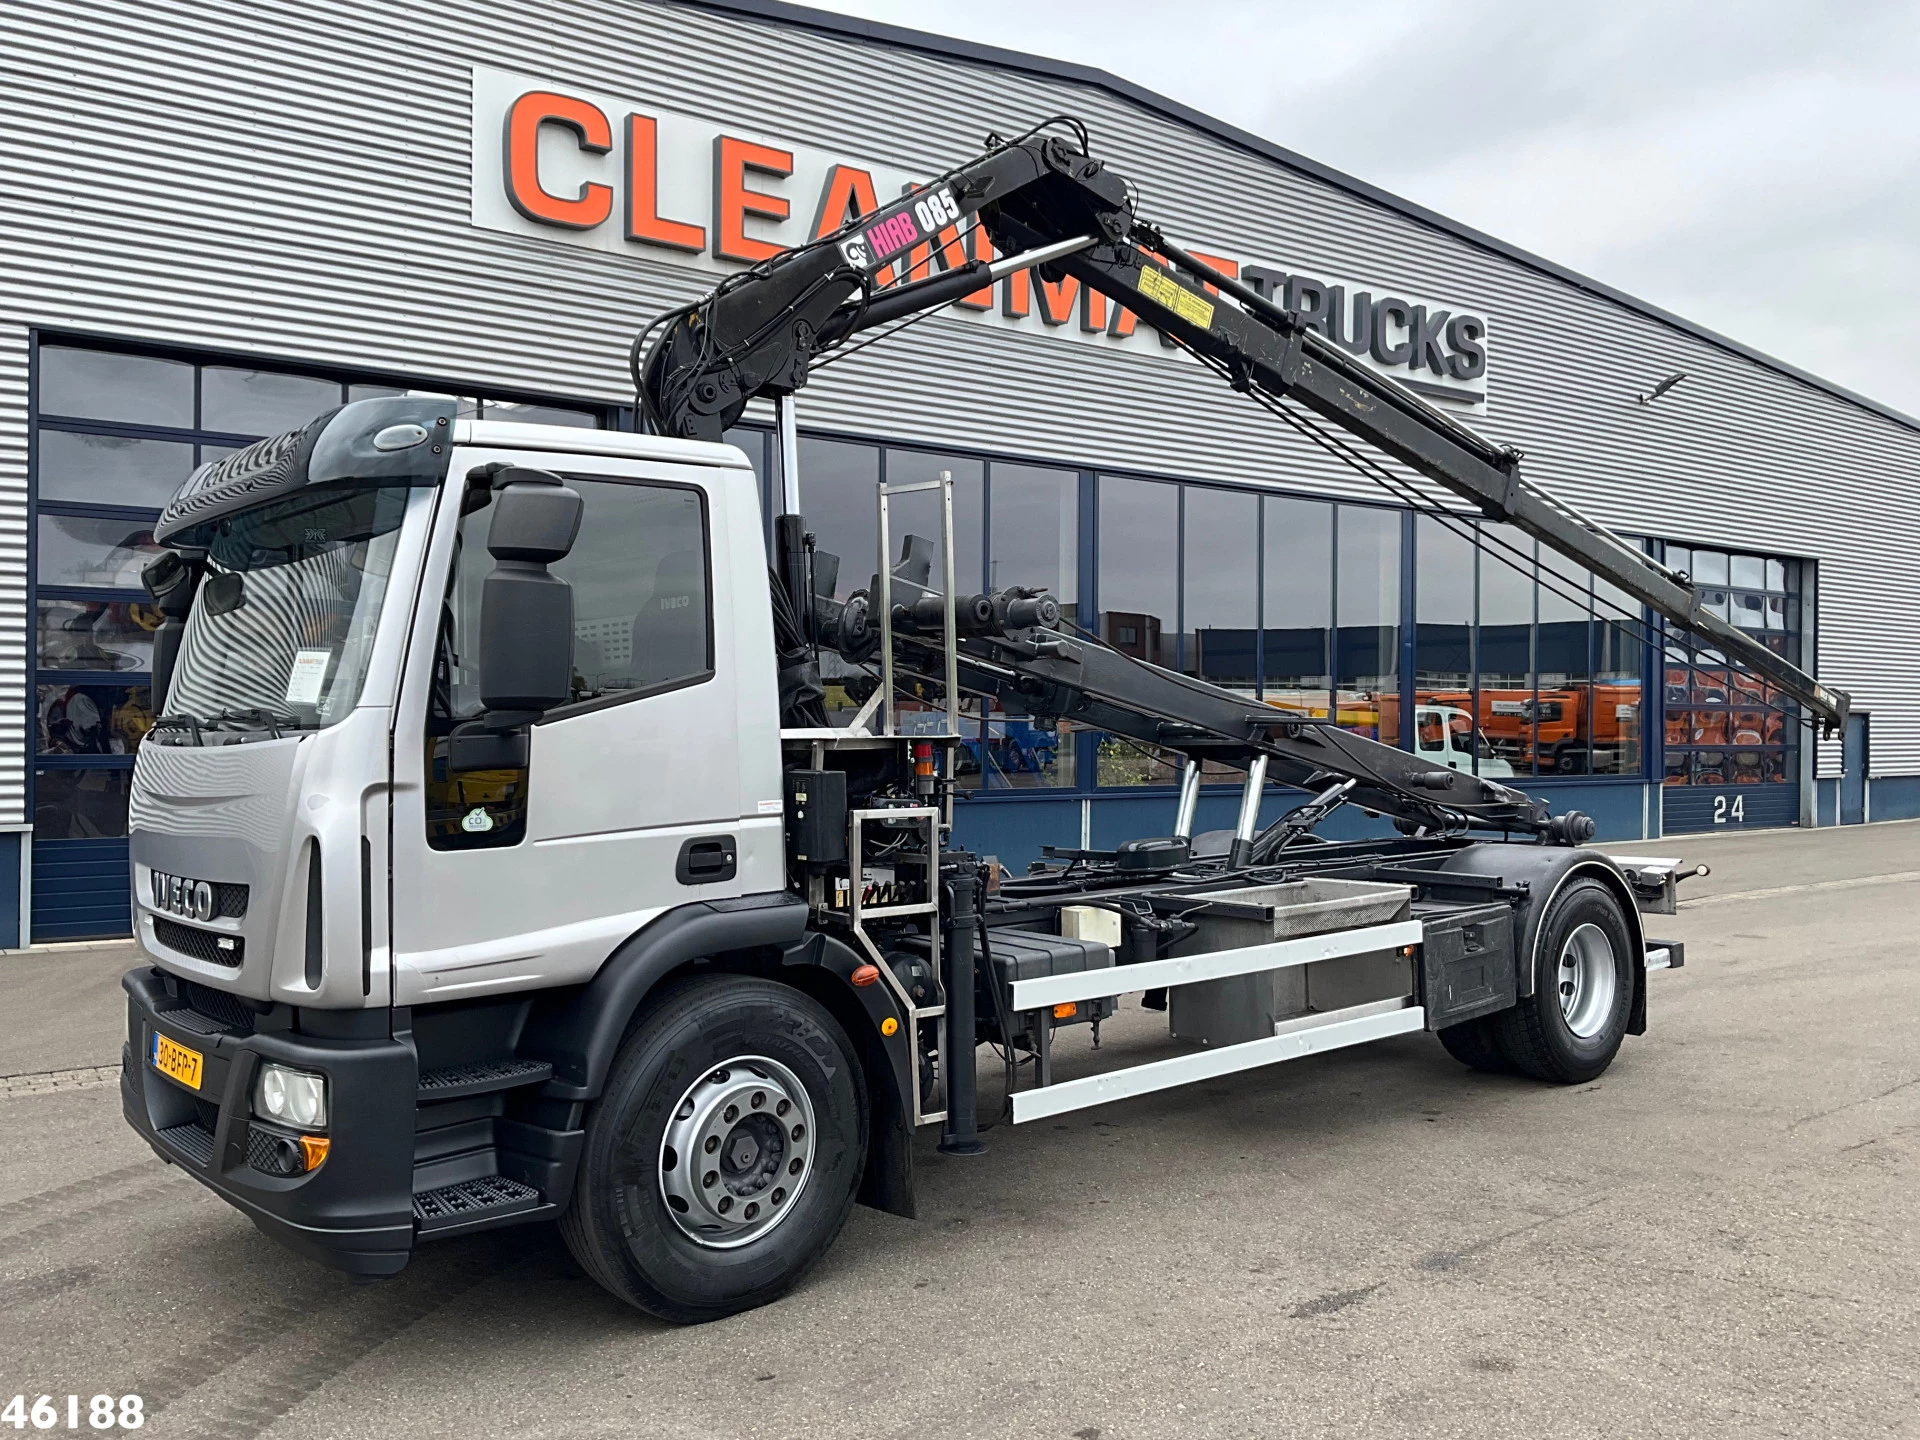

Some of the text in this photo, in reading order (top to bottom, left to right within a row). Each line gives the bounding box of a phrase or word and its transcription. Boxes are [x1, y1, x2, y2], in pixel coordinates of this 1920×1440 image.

[503, 90, 1485, 380] CLEANM TRUCKS
[866, 187, 960, 259] HIAB 085
[660, 595, 689, 610] IVECO
[1714, 795, 1744, 823] 24
[153, 871, 214, 922] IVECO
[159, 1041, 198, 1082] 30-BFP-7
